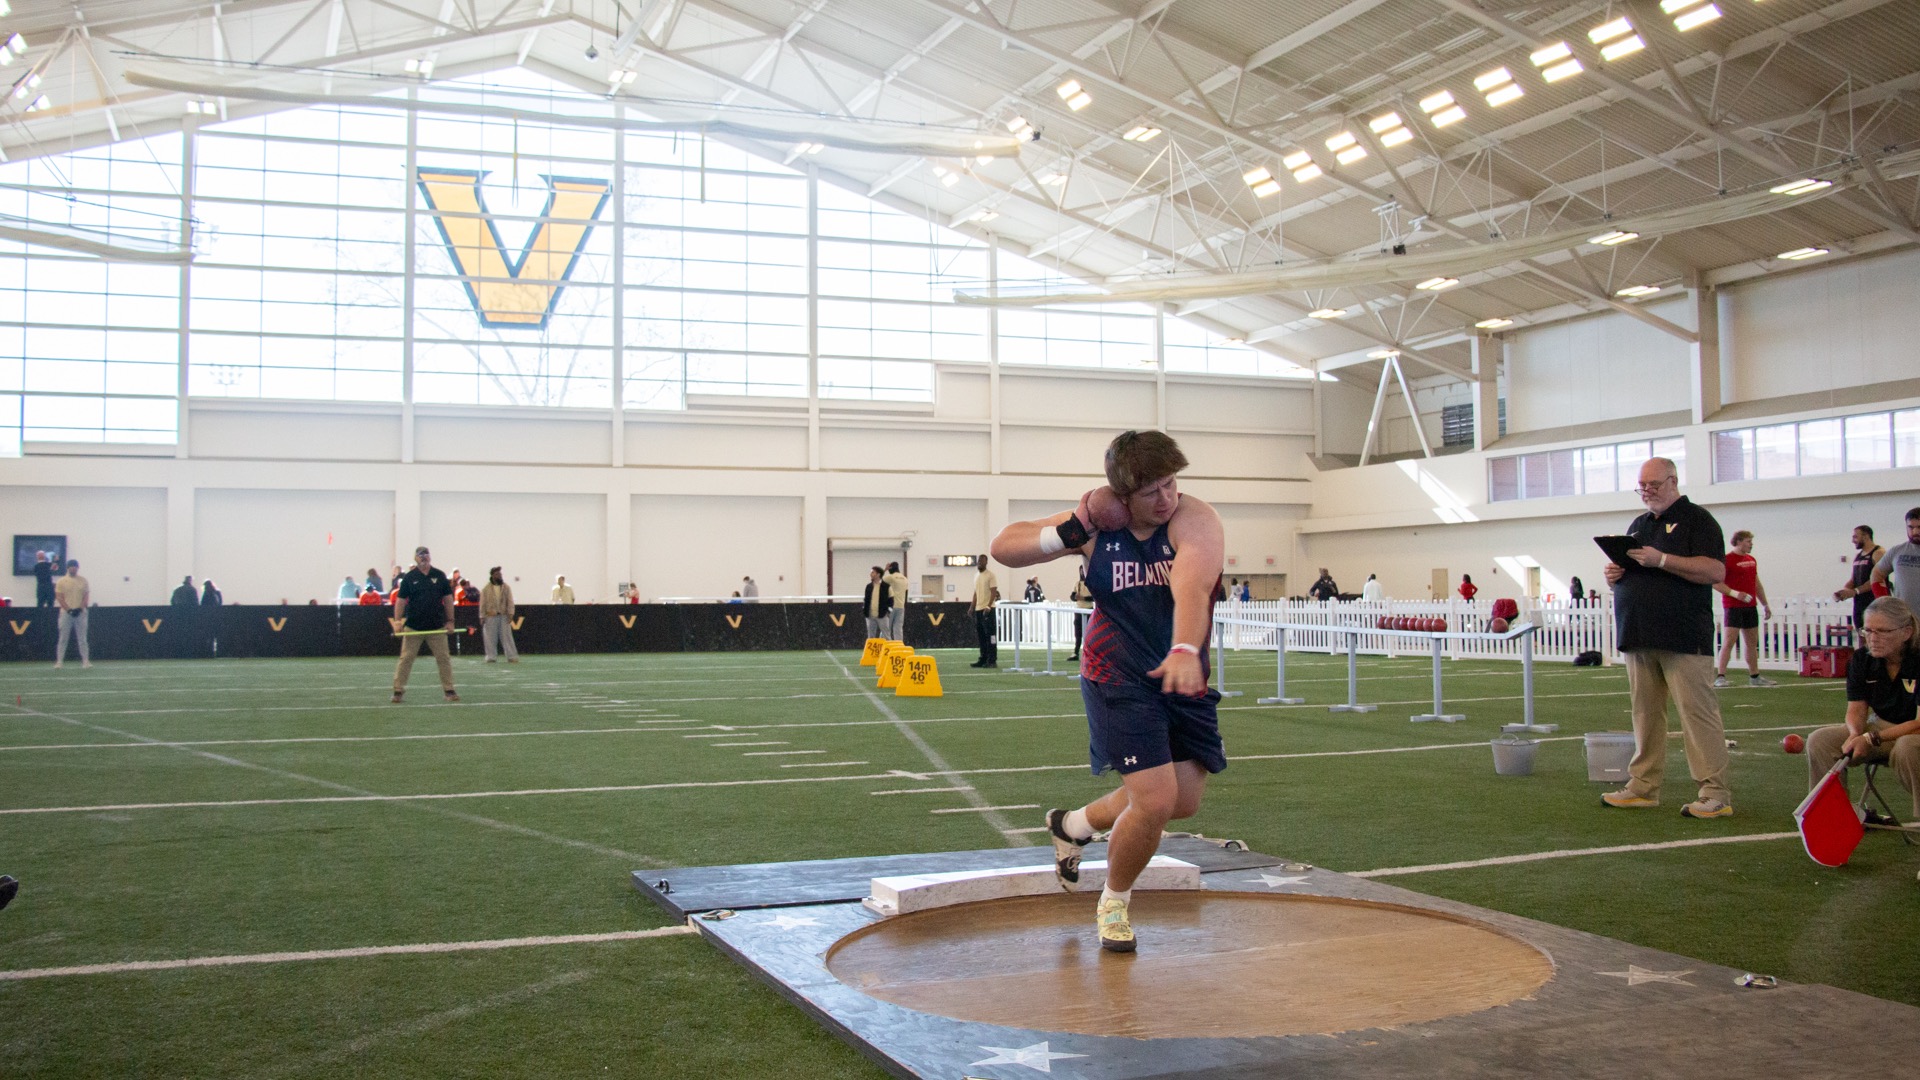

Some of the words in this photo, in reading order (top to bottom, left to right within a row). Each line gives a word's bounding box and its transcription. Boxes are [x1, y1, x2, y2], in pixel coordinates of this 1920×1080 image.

[403, 164, 612, 331] V
[1665, 523, 1677, 533] V
[142, 619, 162, 633] V
[267, 617, 287, 632] V
[619, 615, 637, 628] V
[725, 615, 743, 628] V
[829, 613, 846, 627] V
[928, 613, 945, 626] V
[9, 620, 31, 635] V
[908, 661, 931, 673] 14m
[1901, 678, 1916, 693] V
